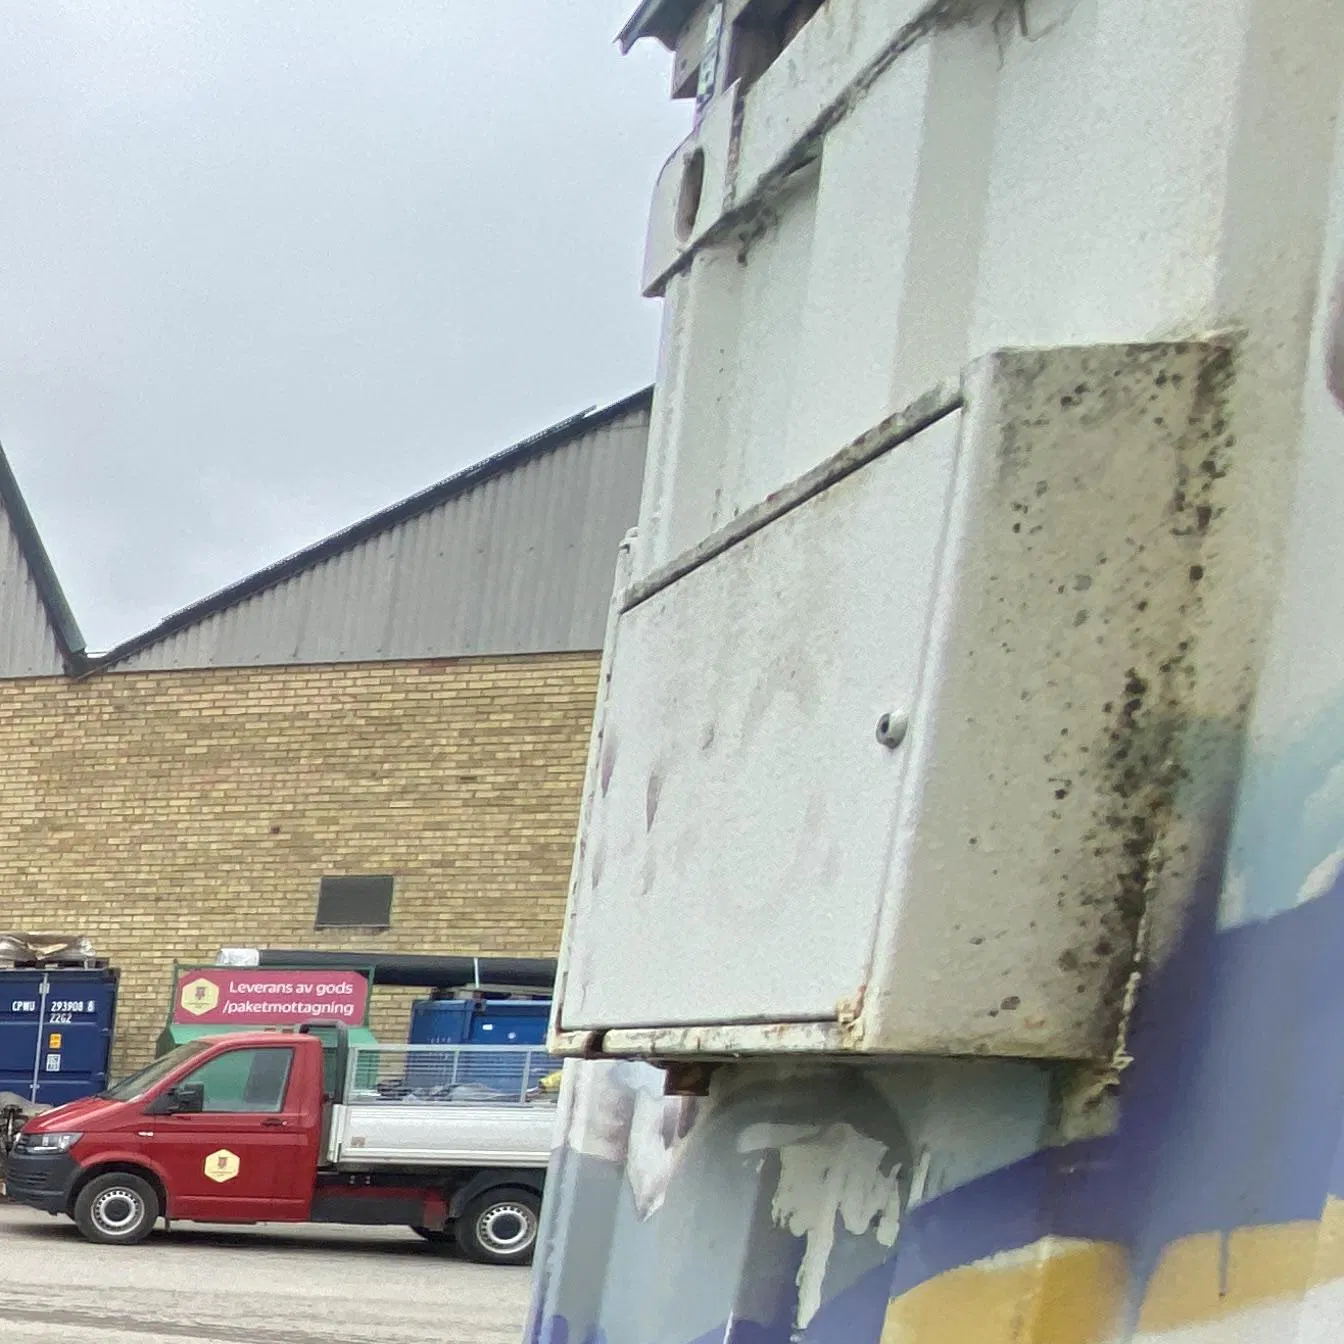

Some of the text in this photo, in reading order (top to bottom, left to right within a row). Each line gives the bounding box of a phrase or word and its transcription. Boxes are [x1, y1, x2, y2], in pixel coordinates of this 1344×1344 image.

[229, 981, 354, 997] Leverans av gods
[222, 1000, 355, 1016] /paketmottagning
